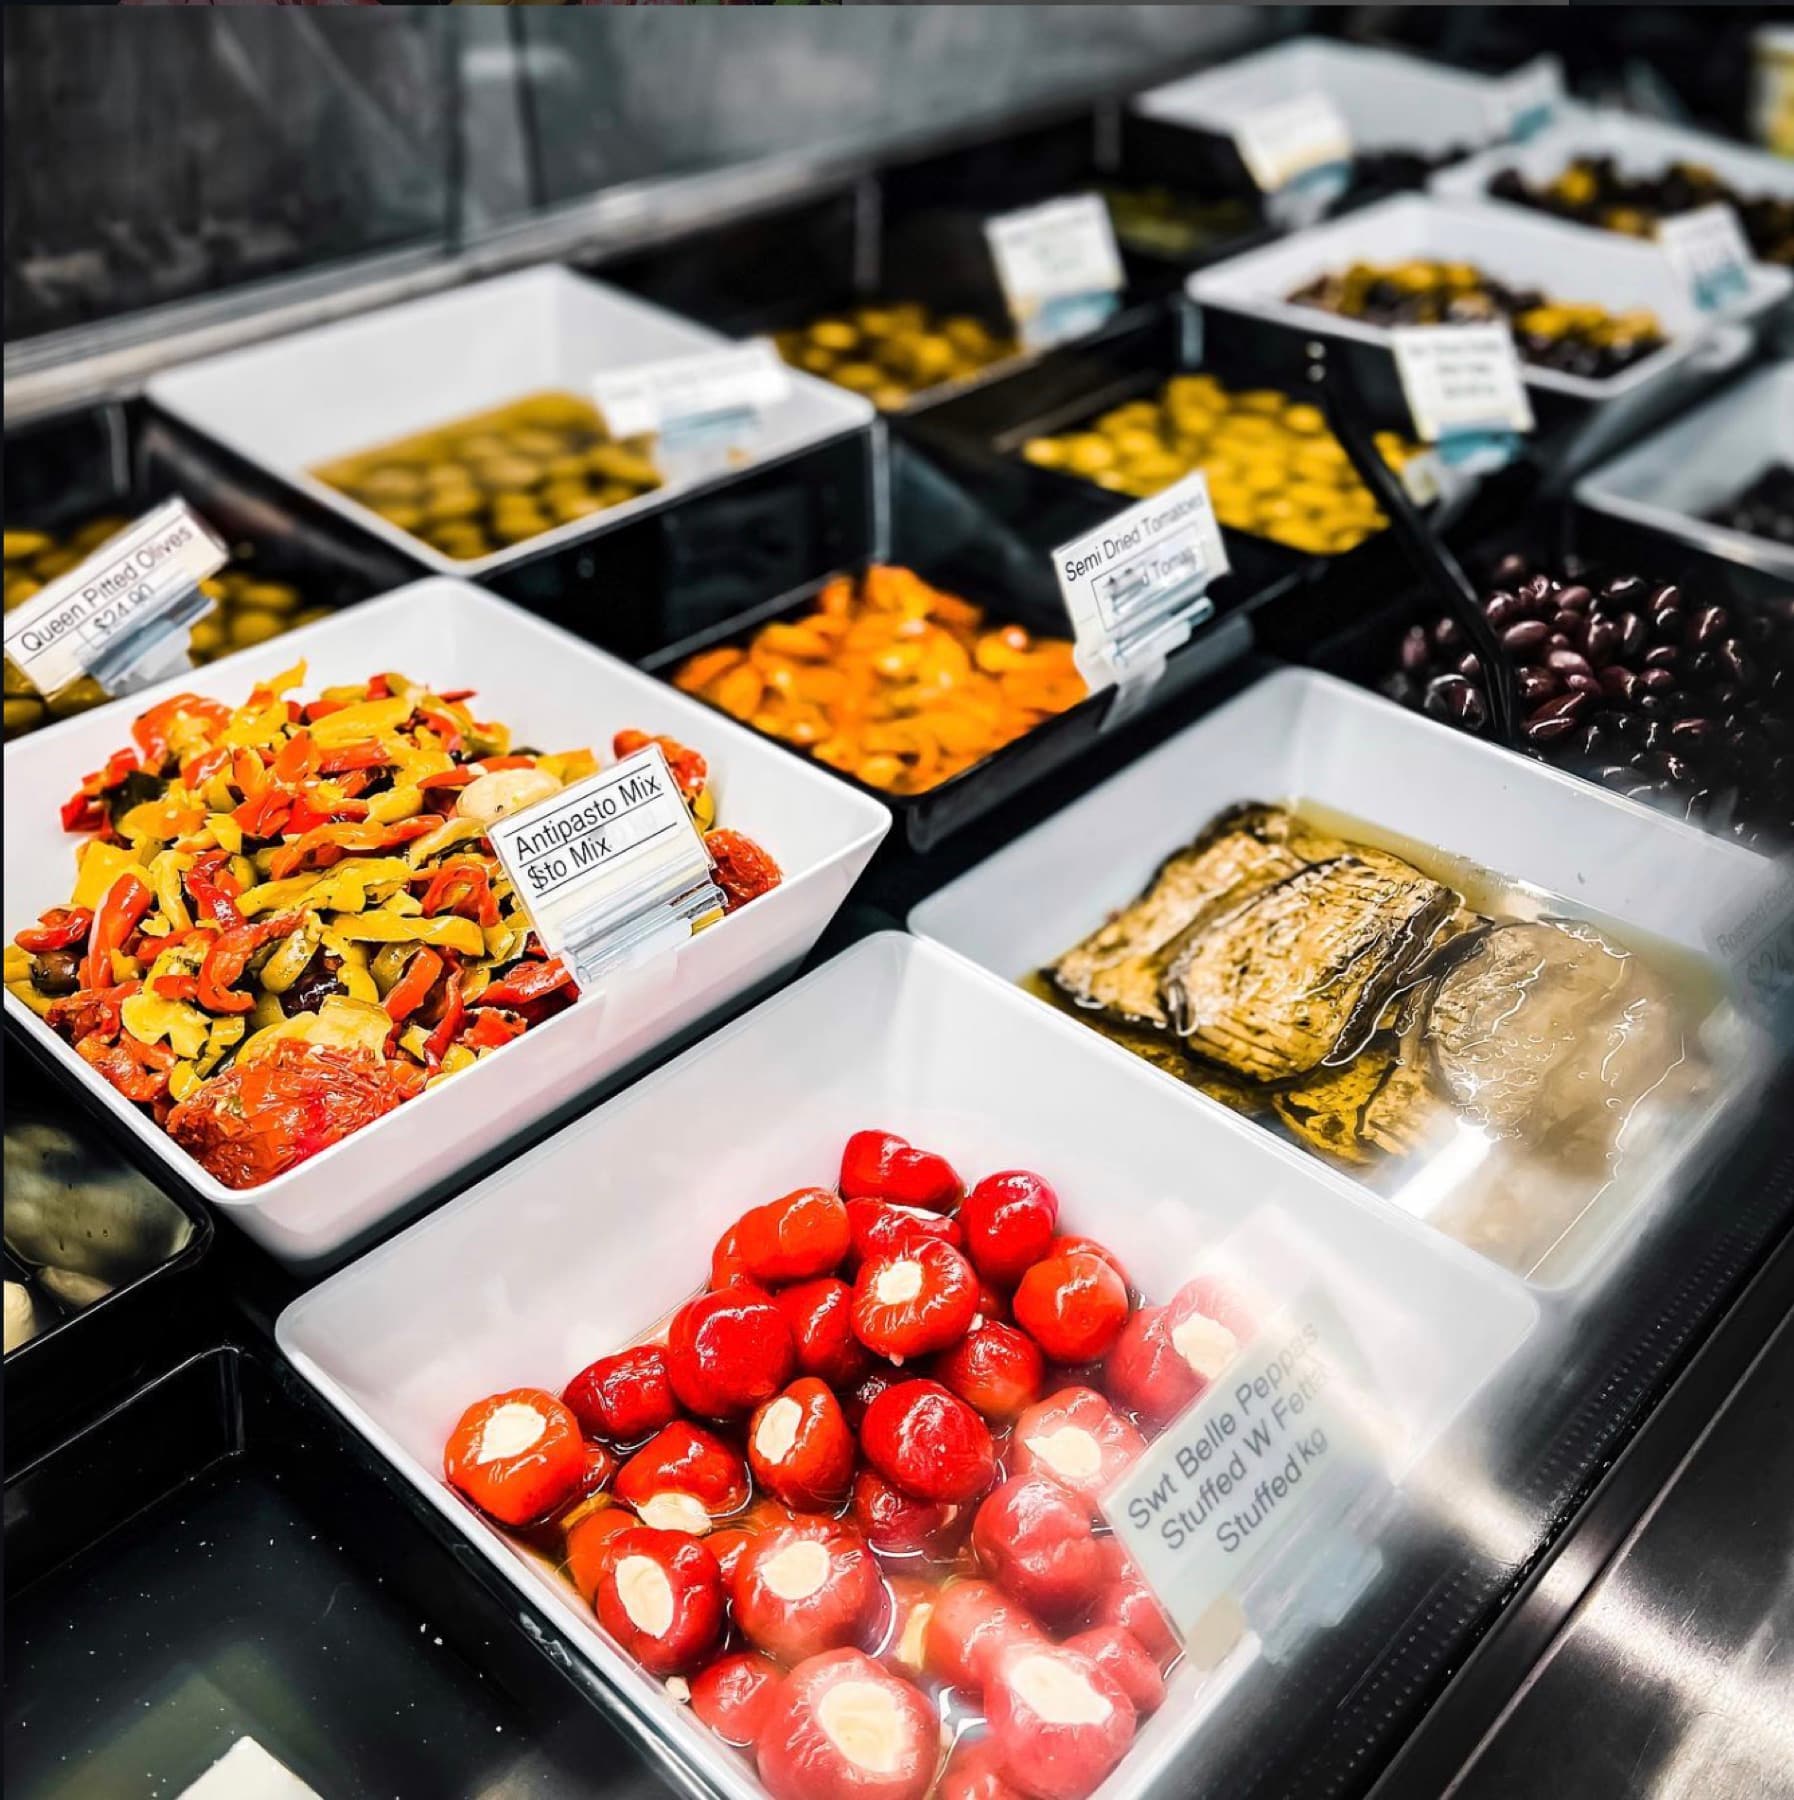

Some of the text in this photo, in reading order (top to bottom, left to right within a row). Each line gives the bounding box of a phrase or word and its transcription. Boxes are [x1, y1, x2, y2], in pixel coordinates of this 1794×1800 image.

[21, 527, 193, 651] Queen Pitted Olives
[1065, 548, 1102, 582] Semi
[1103, 527, 1141, 559] Dried
[516, 776, 660, 861] Antipasto Mix
[569, 836, 611, 868] Mix
[1128, 1473, 1177, 1529] Swt
[1175, 1413, 1236, 1478] Belle
[1161, 1451, 1247, 1550] Stuffed
[1242, 1419, 1273, 1458] W
[1216, 1429, 1328, 1553] Stuffed kg
